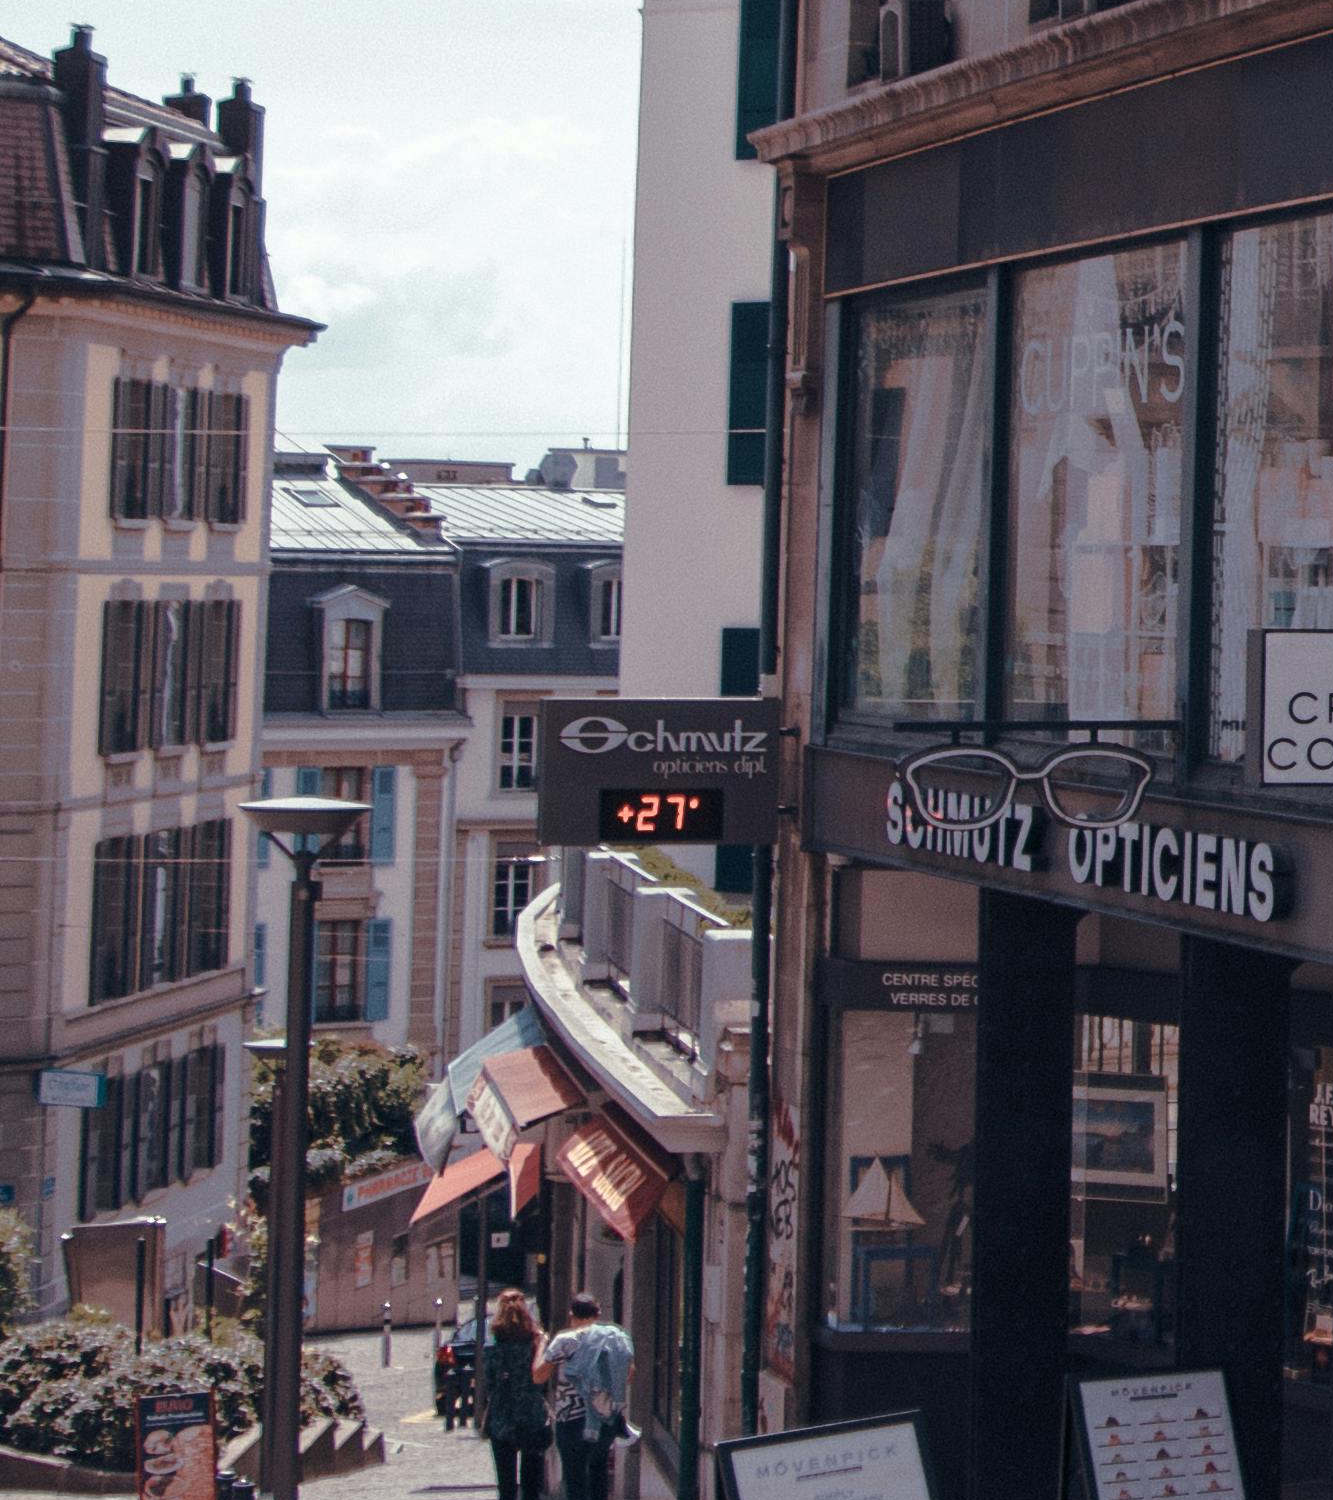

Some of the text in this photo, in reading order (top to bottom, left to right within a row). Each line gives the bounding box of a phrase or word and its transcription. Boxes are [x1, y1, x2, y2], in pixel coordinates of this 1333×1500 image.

[560, 716, 768, 754] Schmutz
[653, 757, 728, 779] opticiens
[886, 781, 1274, 922] SCHMUTZ OPTICIENS
[882, 972, 939, 987] CENTRE
[891, 992, 946, 1006] VERRES
[951, 994, 970, 1006] DE
